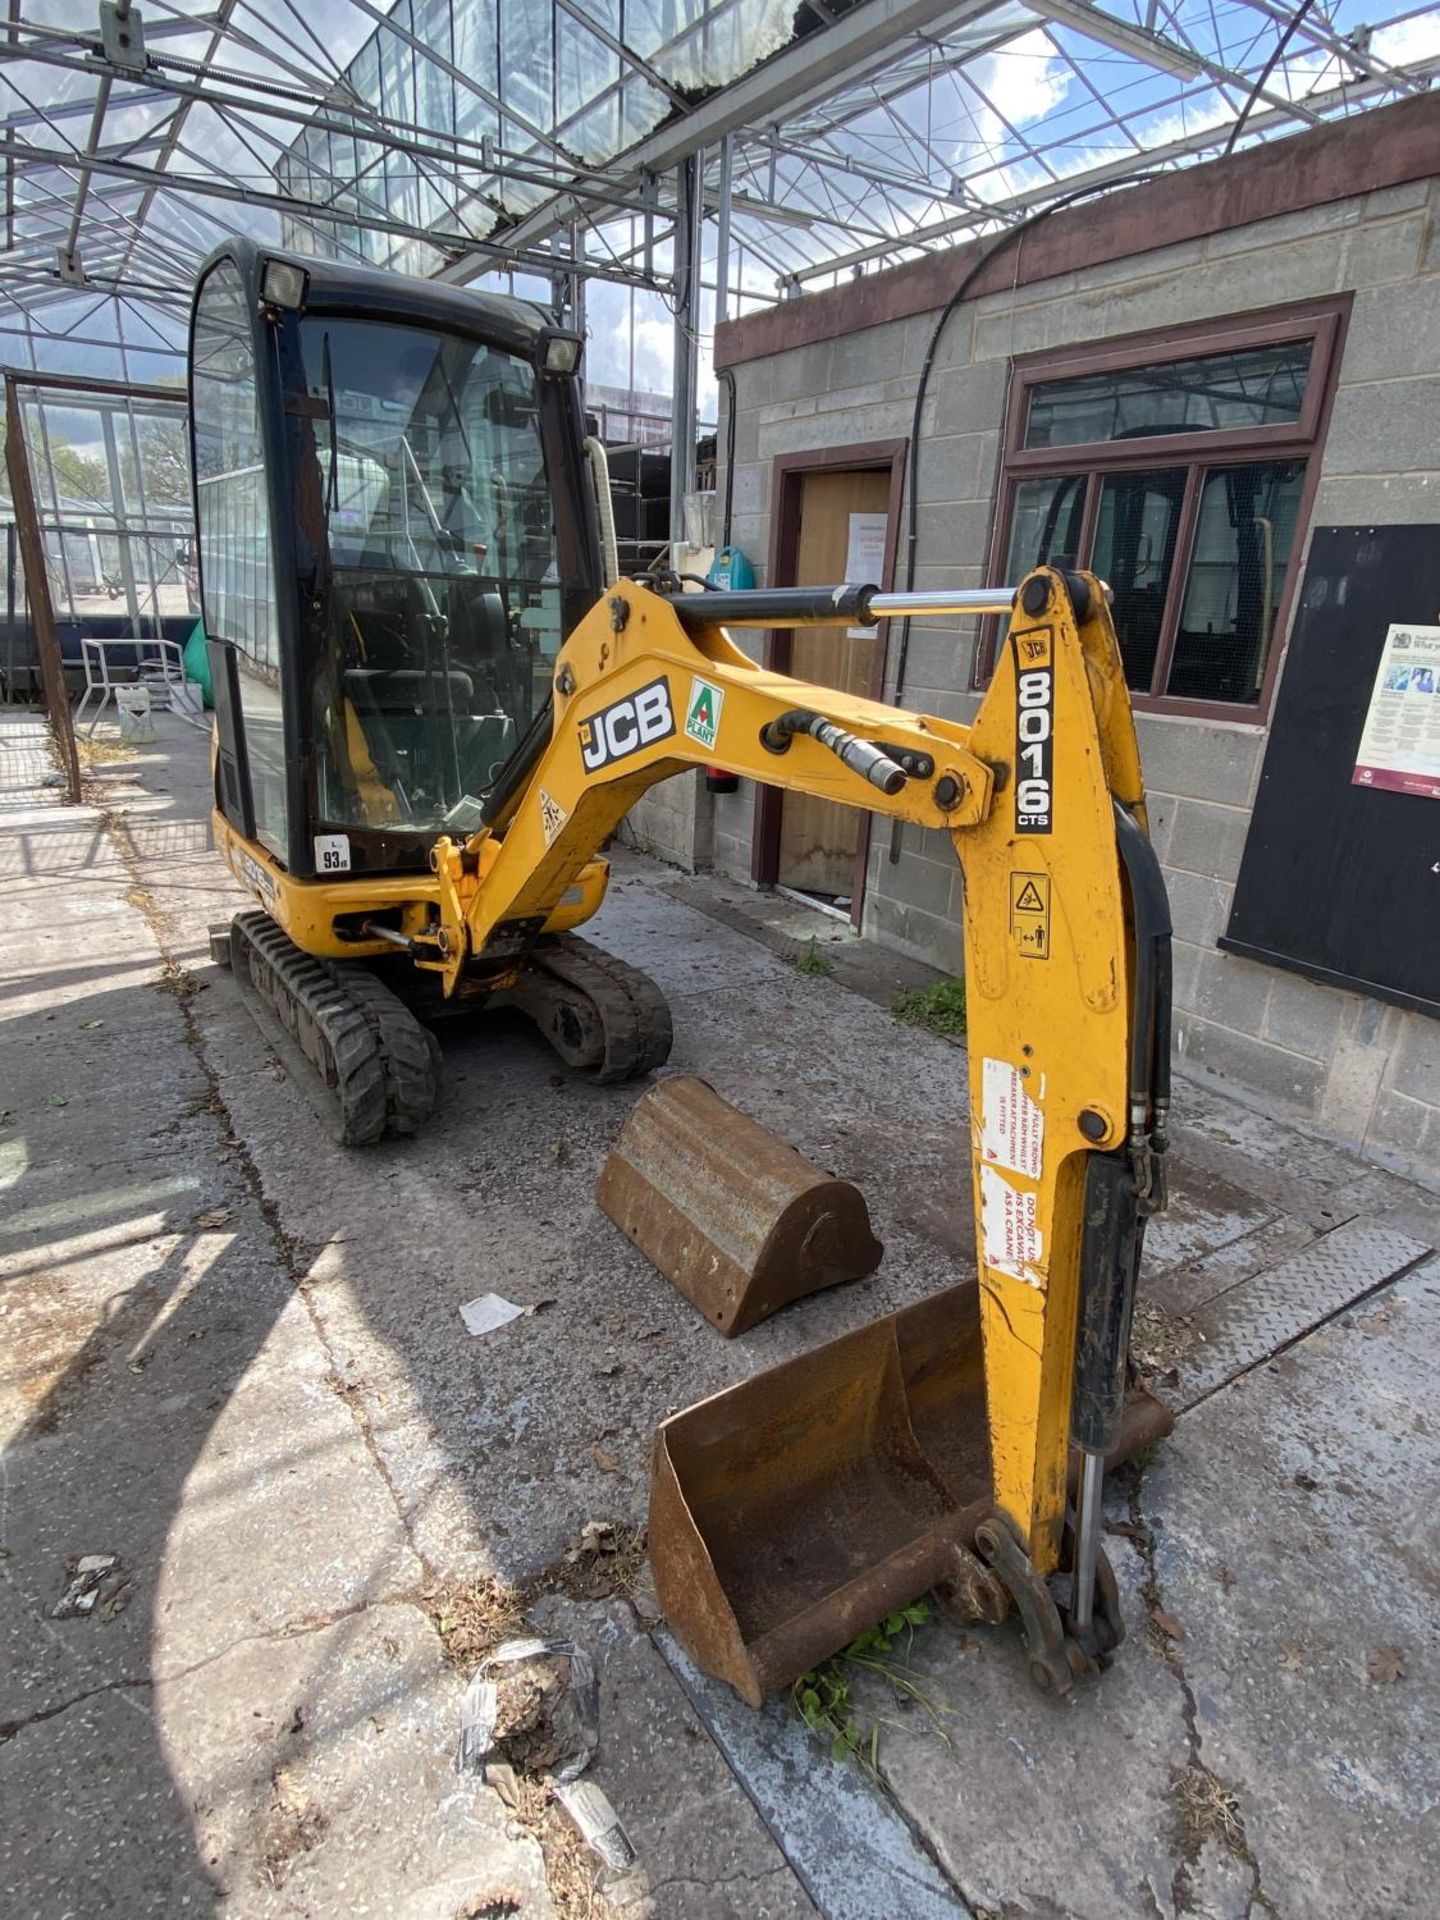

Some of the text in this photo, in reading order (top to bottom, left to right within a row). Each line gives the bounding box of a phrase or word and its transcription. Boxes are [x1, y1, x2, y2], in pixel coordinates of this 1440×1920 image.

[690, 686, 714, 730] A
[583, 684, 673, 769] JCB
[688, 720, 715, 744] PLANT
[1018, 671, 1050, 813] 8016
[1018, 814, 1048, 825] CTS
[323, 851, 340, 869] 93
[1000, 1096, 1006, 1104] IS
[1009, 1109, 1017, 1166] ATTACHMENT
[1020, 1117, 1028, 1136] RAM
[1031, 1113, 1039, 1139] FULLY
[1020, 1137, 1028, 1169] WHILST
[1031, 1140, 1039, 1174] CROWD
[1027, 1197, 1035, 1216] DO
[1005, 1191, 1014, 1258] AS A CRANE
[1027, 1218, 1036, 1245] NOT
[1015, 1209, 1024, 1278] EXCAVATOR
